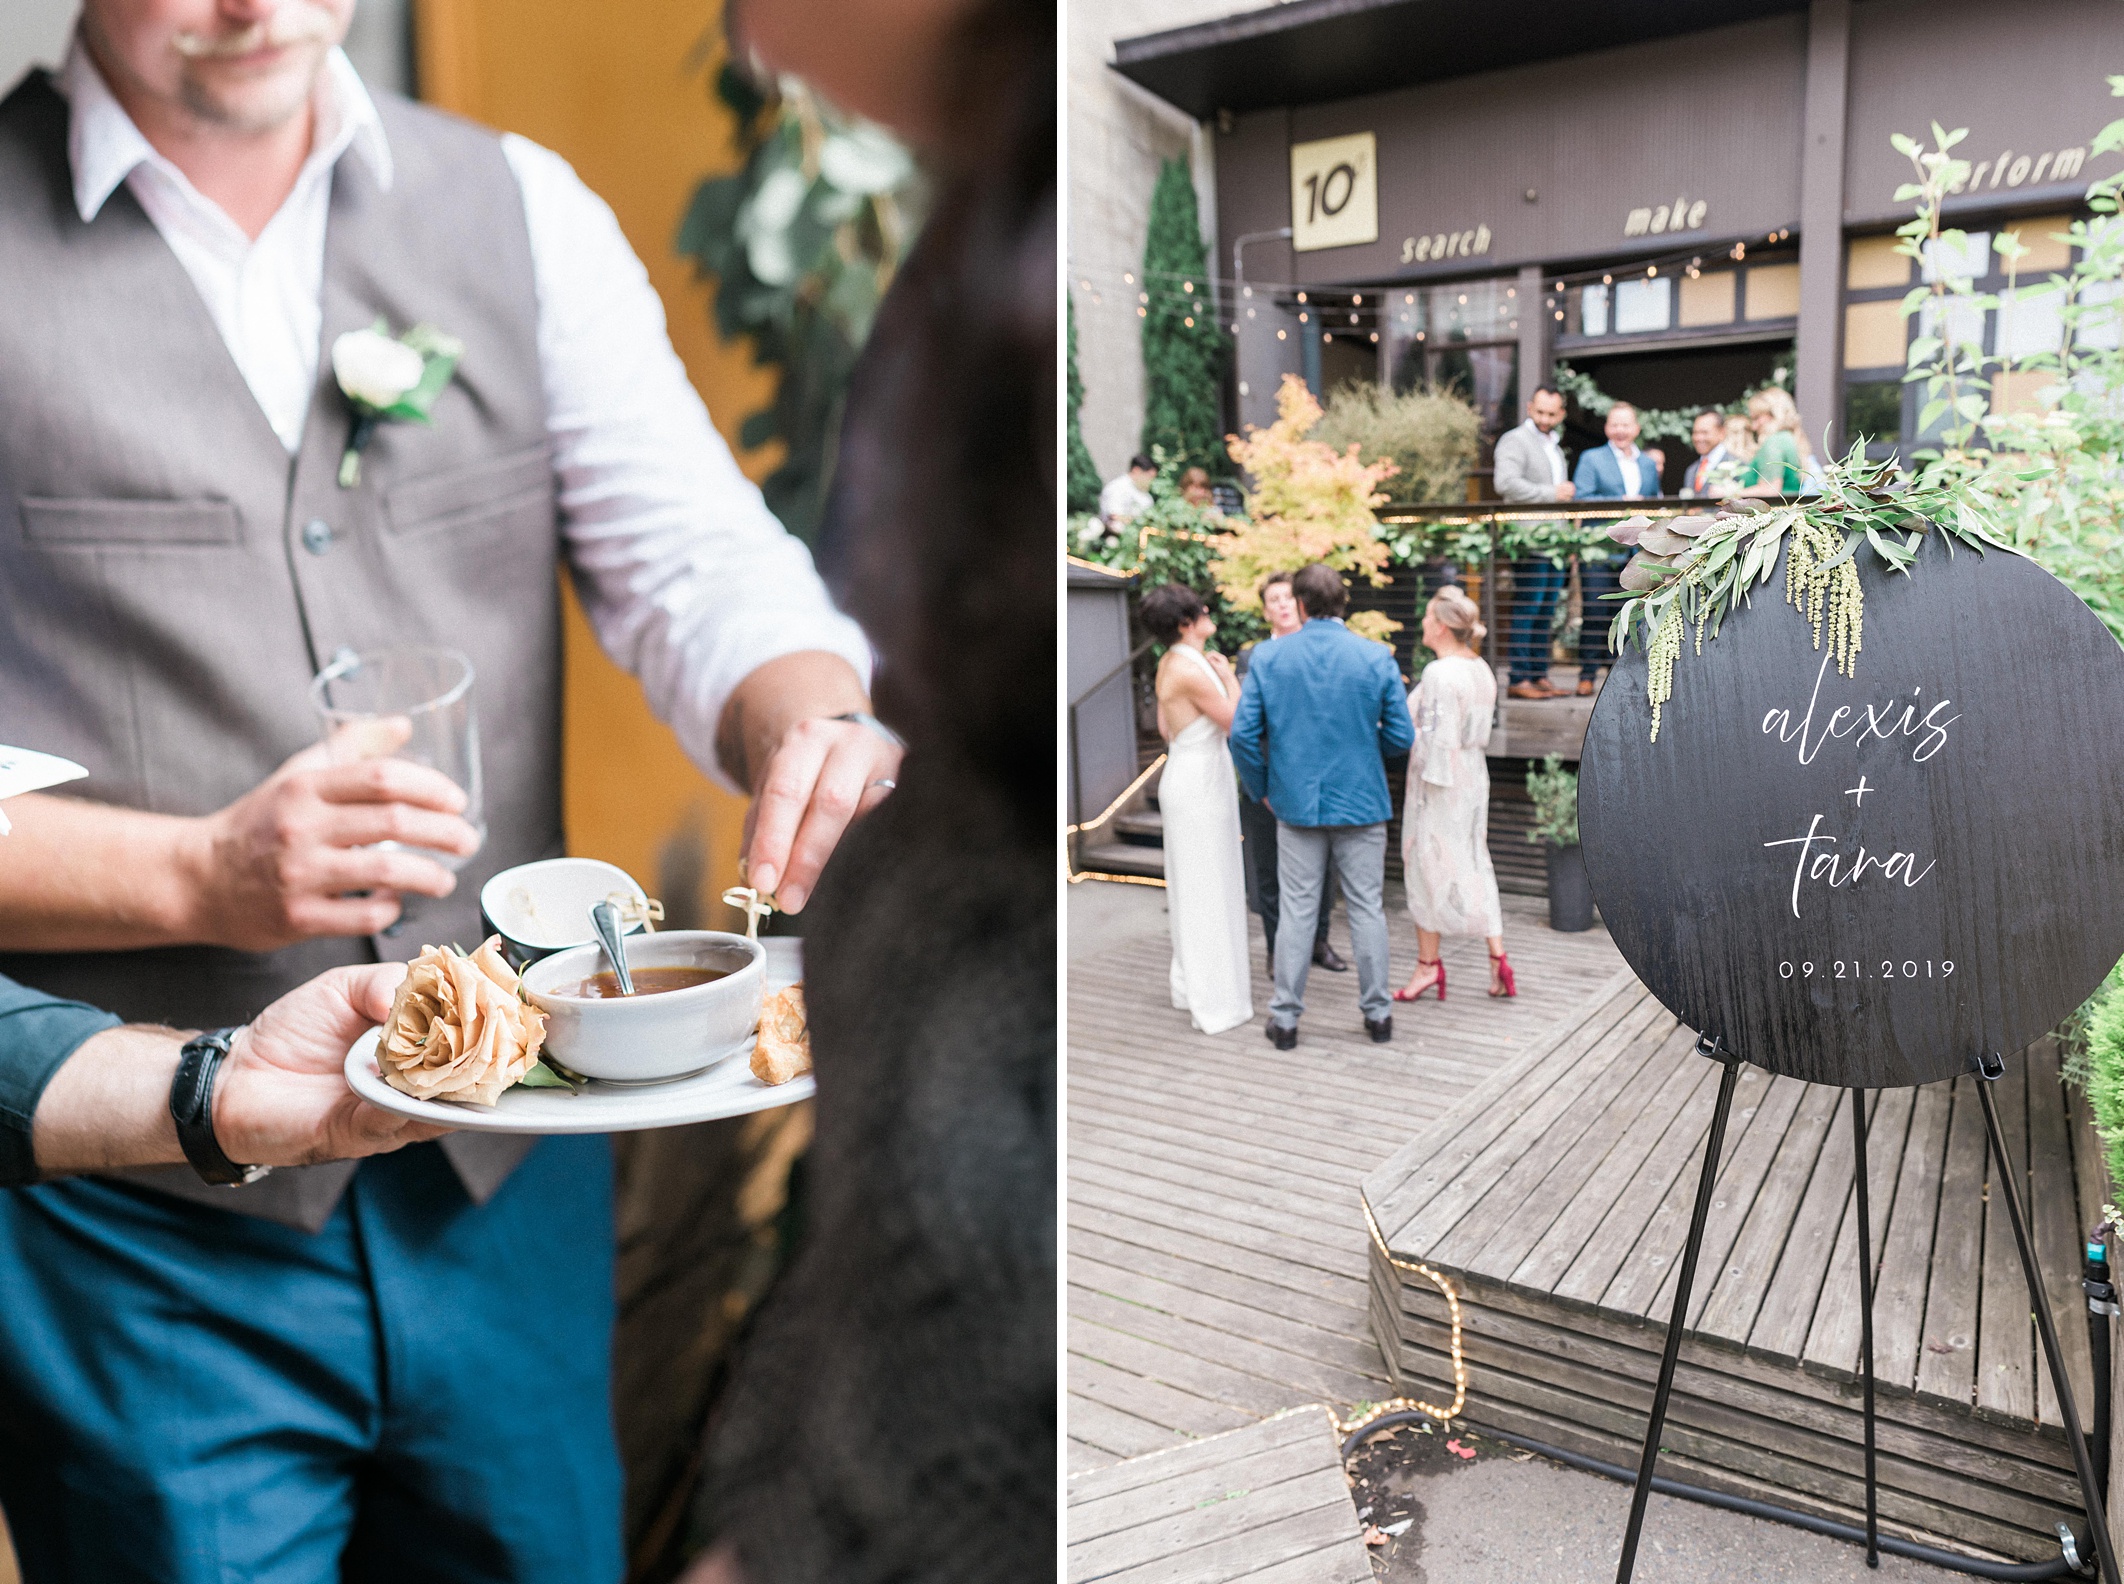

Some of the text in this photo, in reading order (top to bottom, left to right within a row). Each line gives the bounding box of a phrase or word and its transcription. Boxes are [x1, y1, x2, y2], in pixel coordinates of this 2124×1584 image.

[1623, 196, 1708, 237] make
[1400, 223, 1493, 265] search
[1761, 653, 1963, 765] alexis
[1763, 813, 1937, 919] tara
[1779, 960, 1956, 979] 09.21.2019
